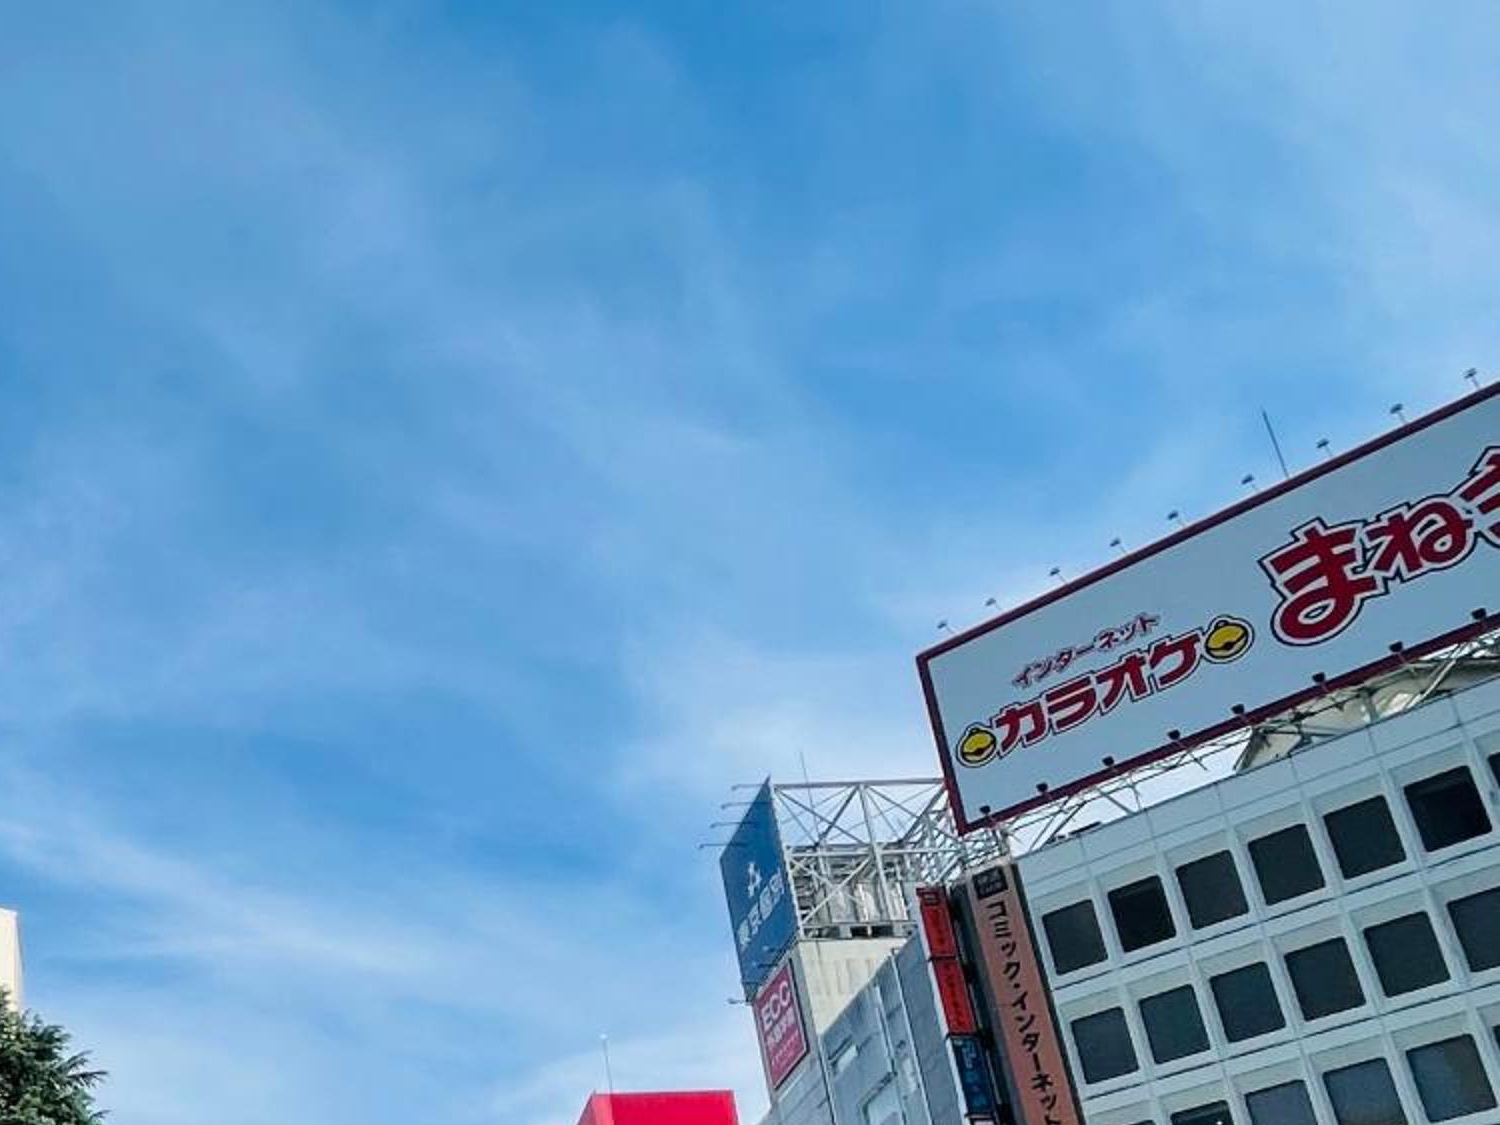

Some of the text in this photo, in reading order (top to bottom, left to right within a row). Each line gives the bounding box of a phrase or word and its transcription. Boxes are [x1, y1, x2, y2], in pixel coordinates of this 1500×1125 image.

[994, 628, 1203, 756] カラオケ
[1013, 611, 1160, 688] インターネット
